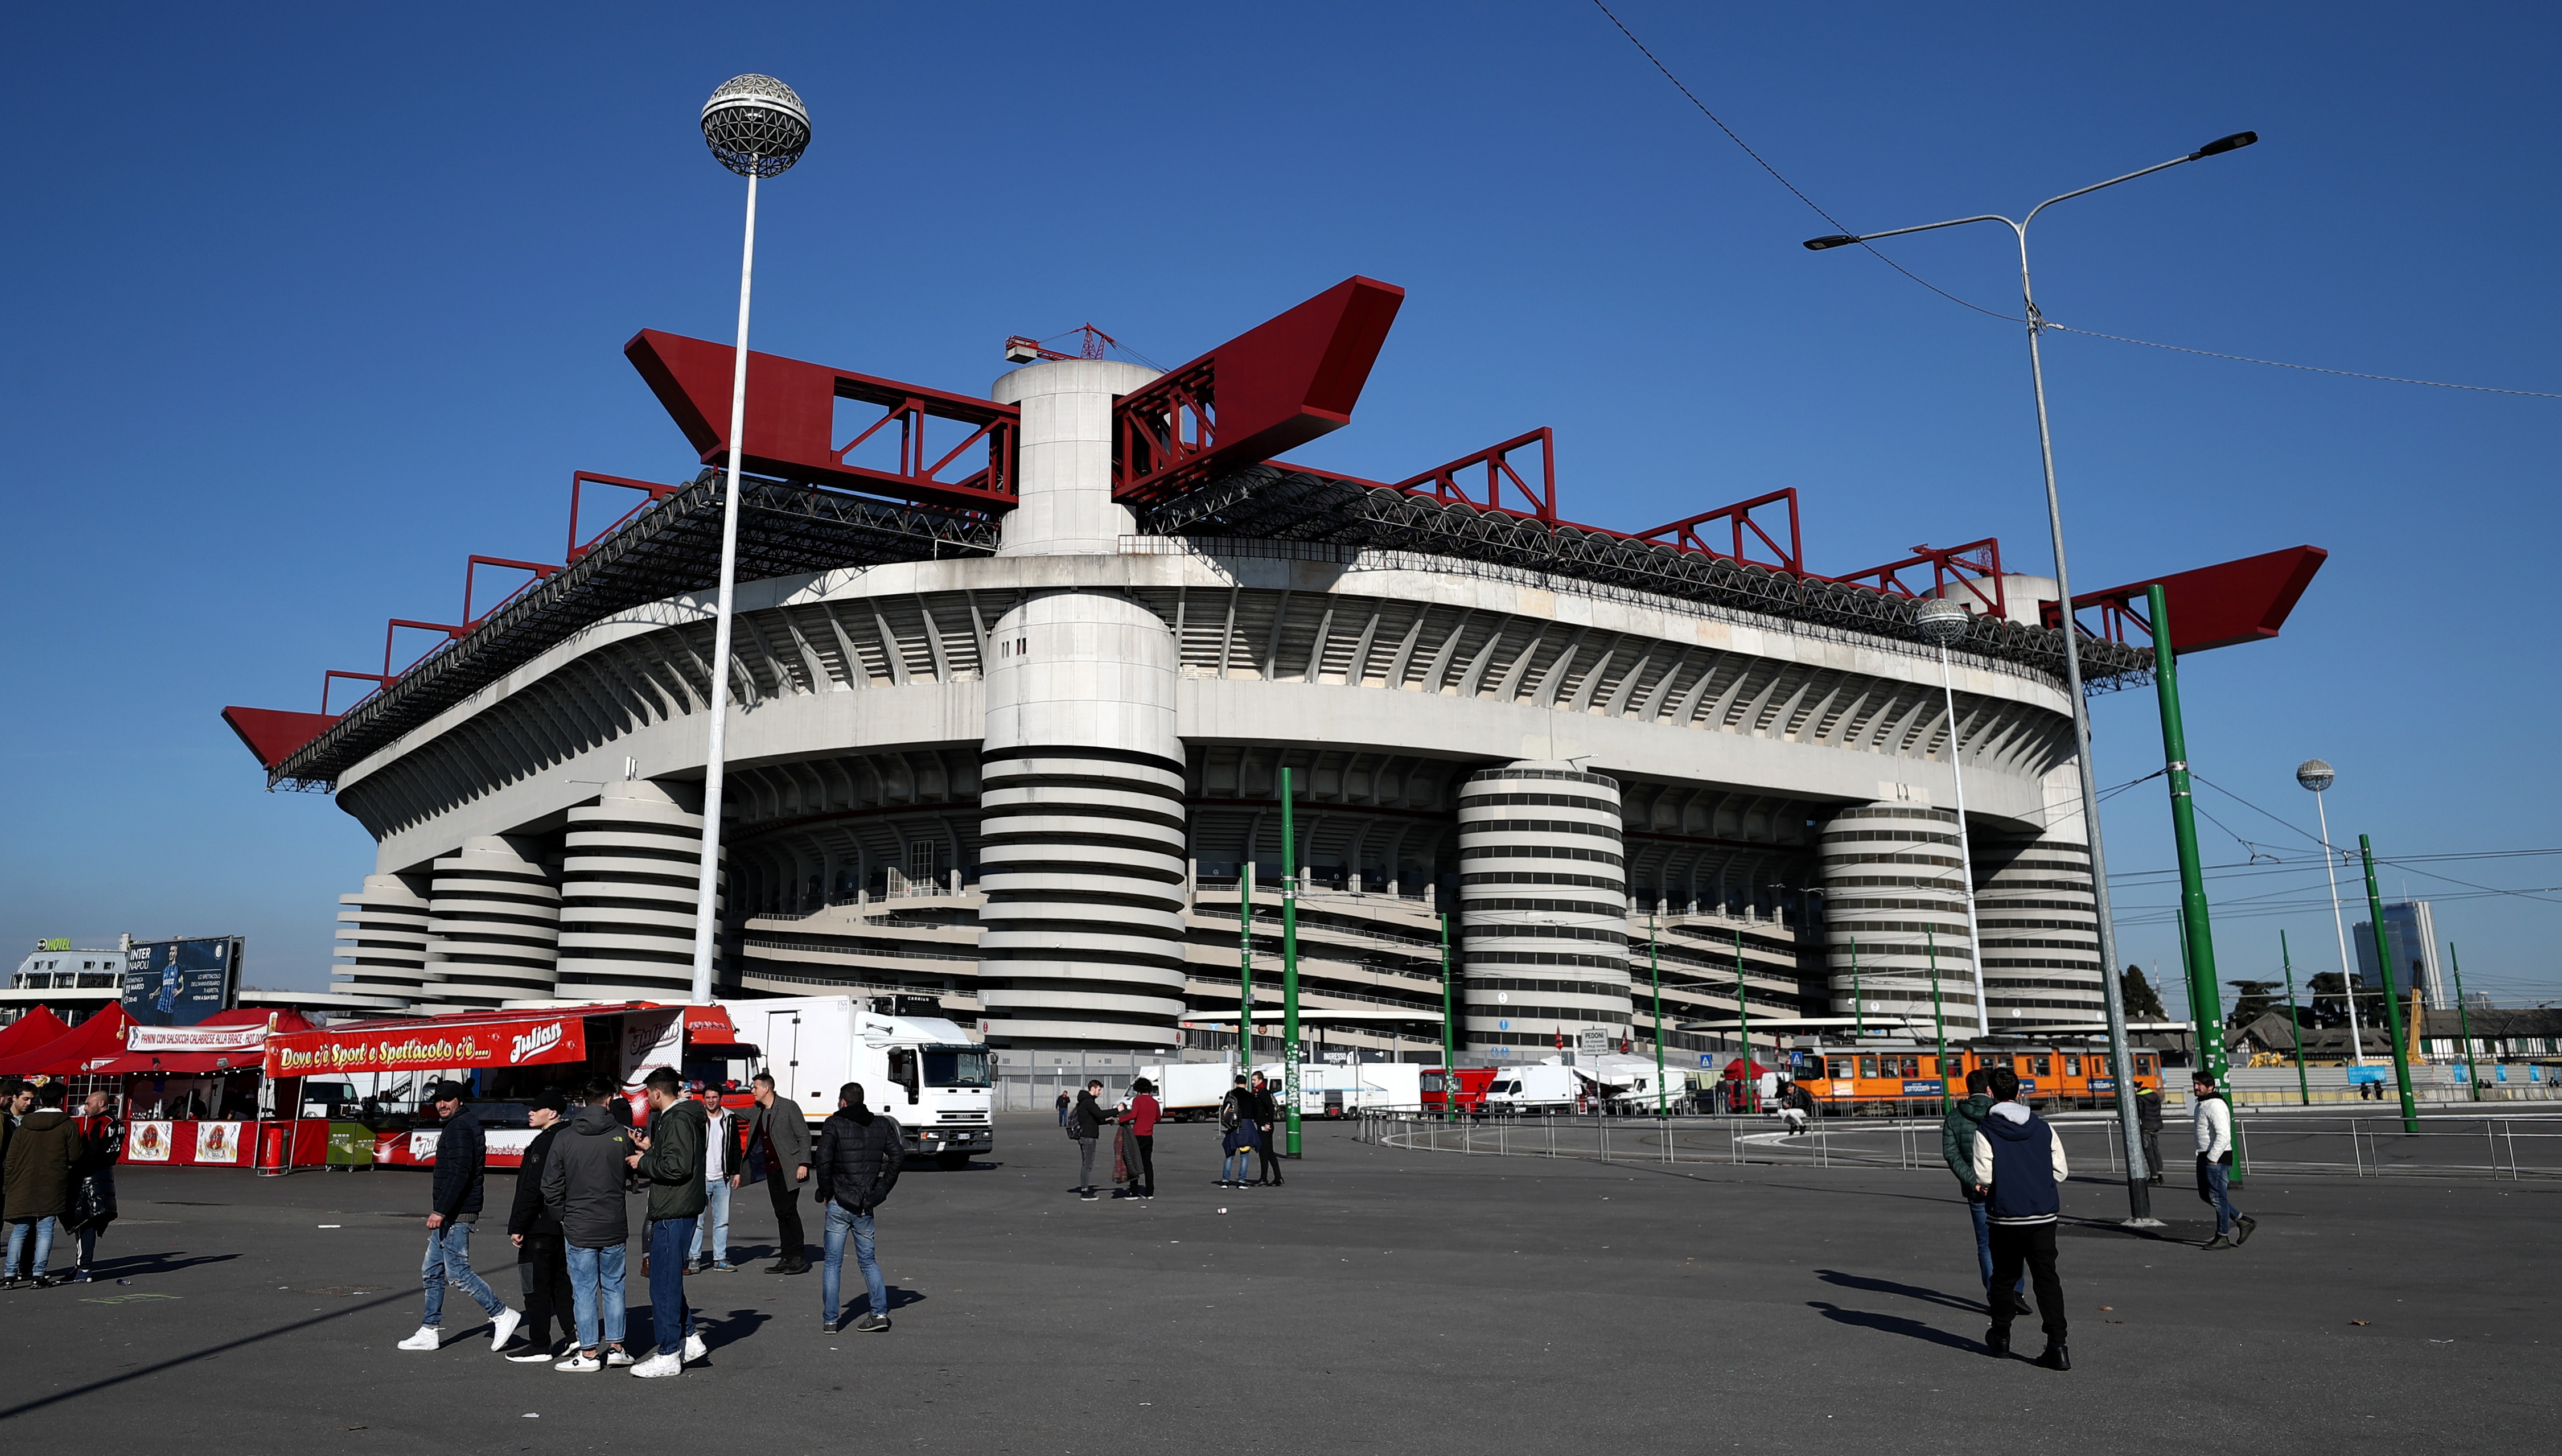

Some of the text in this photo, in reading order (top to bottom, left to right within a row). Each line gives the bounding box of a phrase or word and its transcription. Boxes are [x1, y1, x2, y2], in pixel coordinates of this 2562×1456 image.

[48, 938, 71, 951] HOTEL
[130, 947, 151, 960] INTER
[129, 961, 149, 970] NAPOLI
[125, 985, 130, 994] 11
[141, 1033, 157, 1044] PANINI
[157, 1033, 167, 1044] CON
[166, 1033, 190, 1044] SALSICCIA
[190, 1033, 215, 1044] CALABRESE
[215, 1033, 228, 1044] ALLA
[228, 1033, 243, 1044] BRACE
[245, 1033, 256, 1044] HOT
[510, 1022, 563, 1063] Julian
[630, 1021, 680, 1054] Julian
[281, 1047, 312, 1067] Dove
[314, 1044, 329, 1066] c'è
[332, 1042, 367, 1067] Sport
[368, 1049, 377, 1060] e
[379, 1039, 453, 1066] Spettacolo
[108, 1124, 125, 1137] bin
